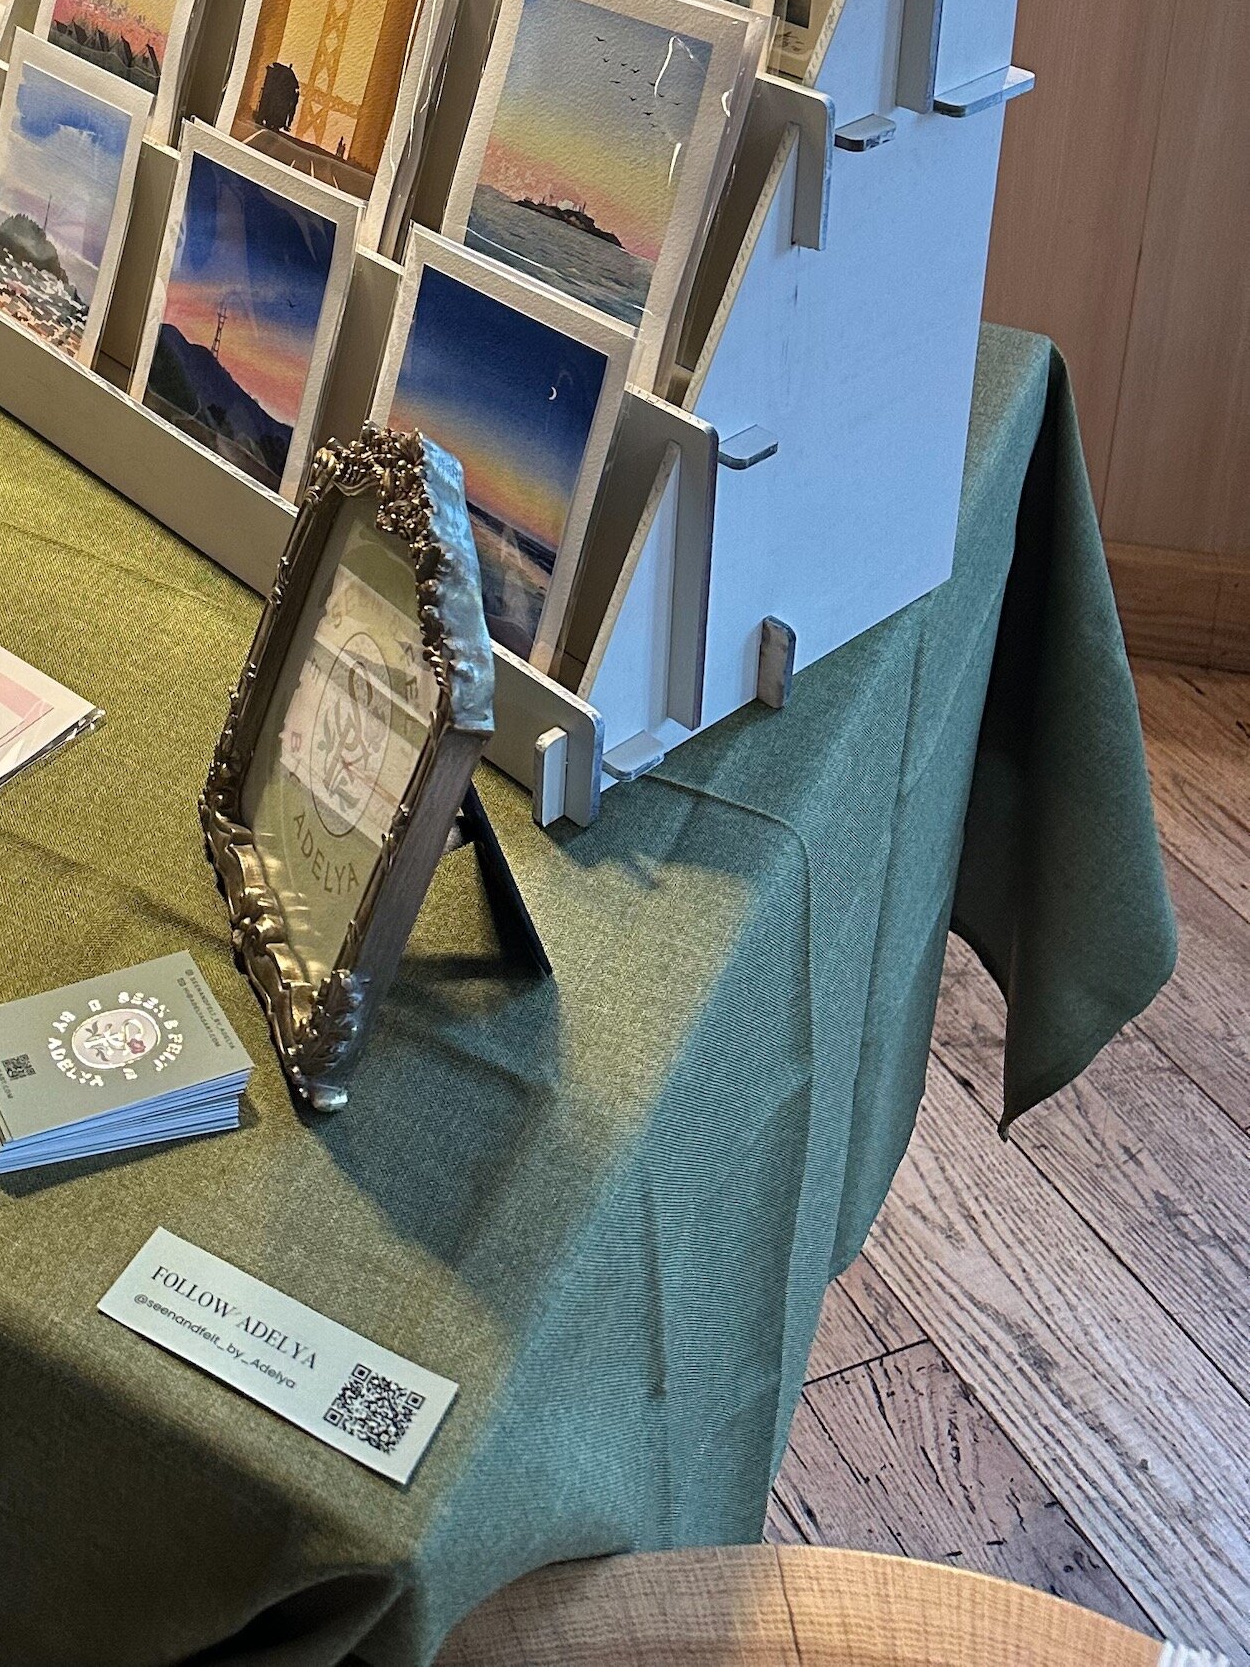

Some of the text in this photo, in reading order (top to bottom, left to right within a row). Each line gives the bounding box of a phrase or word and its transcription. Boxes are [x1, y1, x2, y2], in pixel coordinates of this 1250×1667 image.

[293, 809, 359, 895] ADELYA
[47, 1037, 104, 1087] ADELYA
[52, 1011, 76, 1033] BY
[134, 1293, 297, 1389] @seenandfelt_by_Adelya
[151, 1265, 317, 1370] FOLLOW ADELYA
